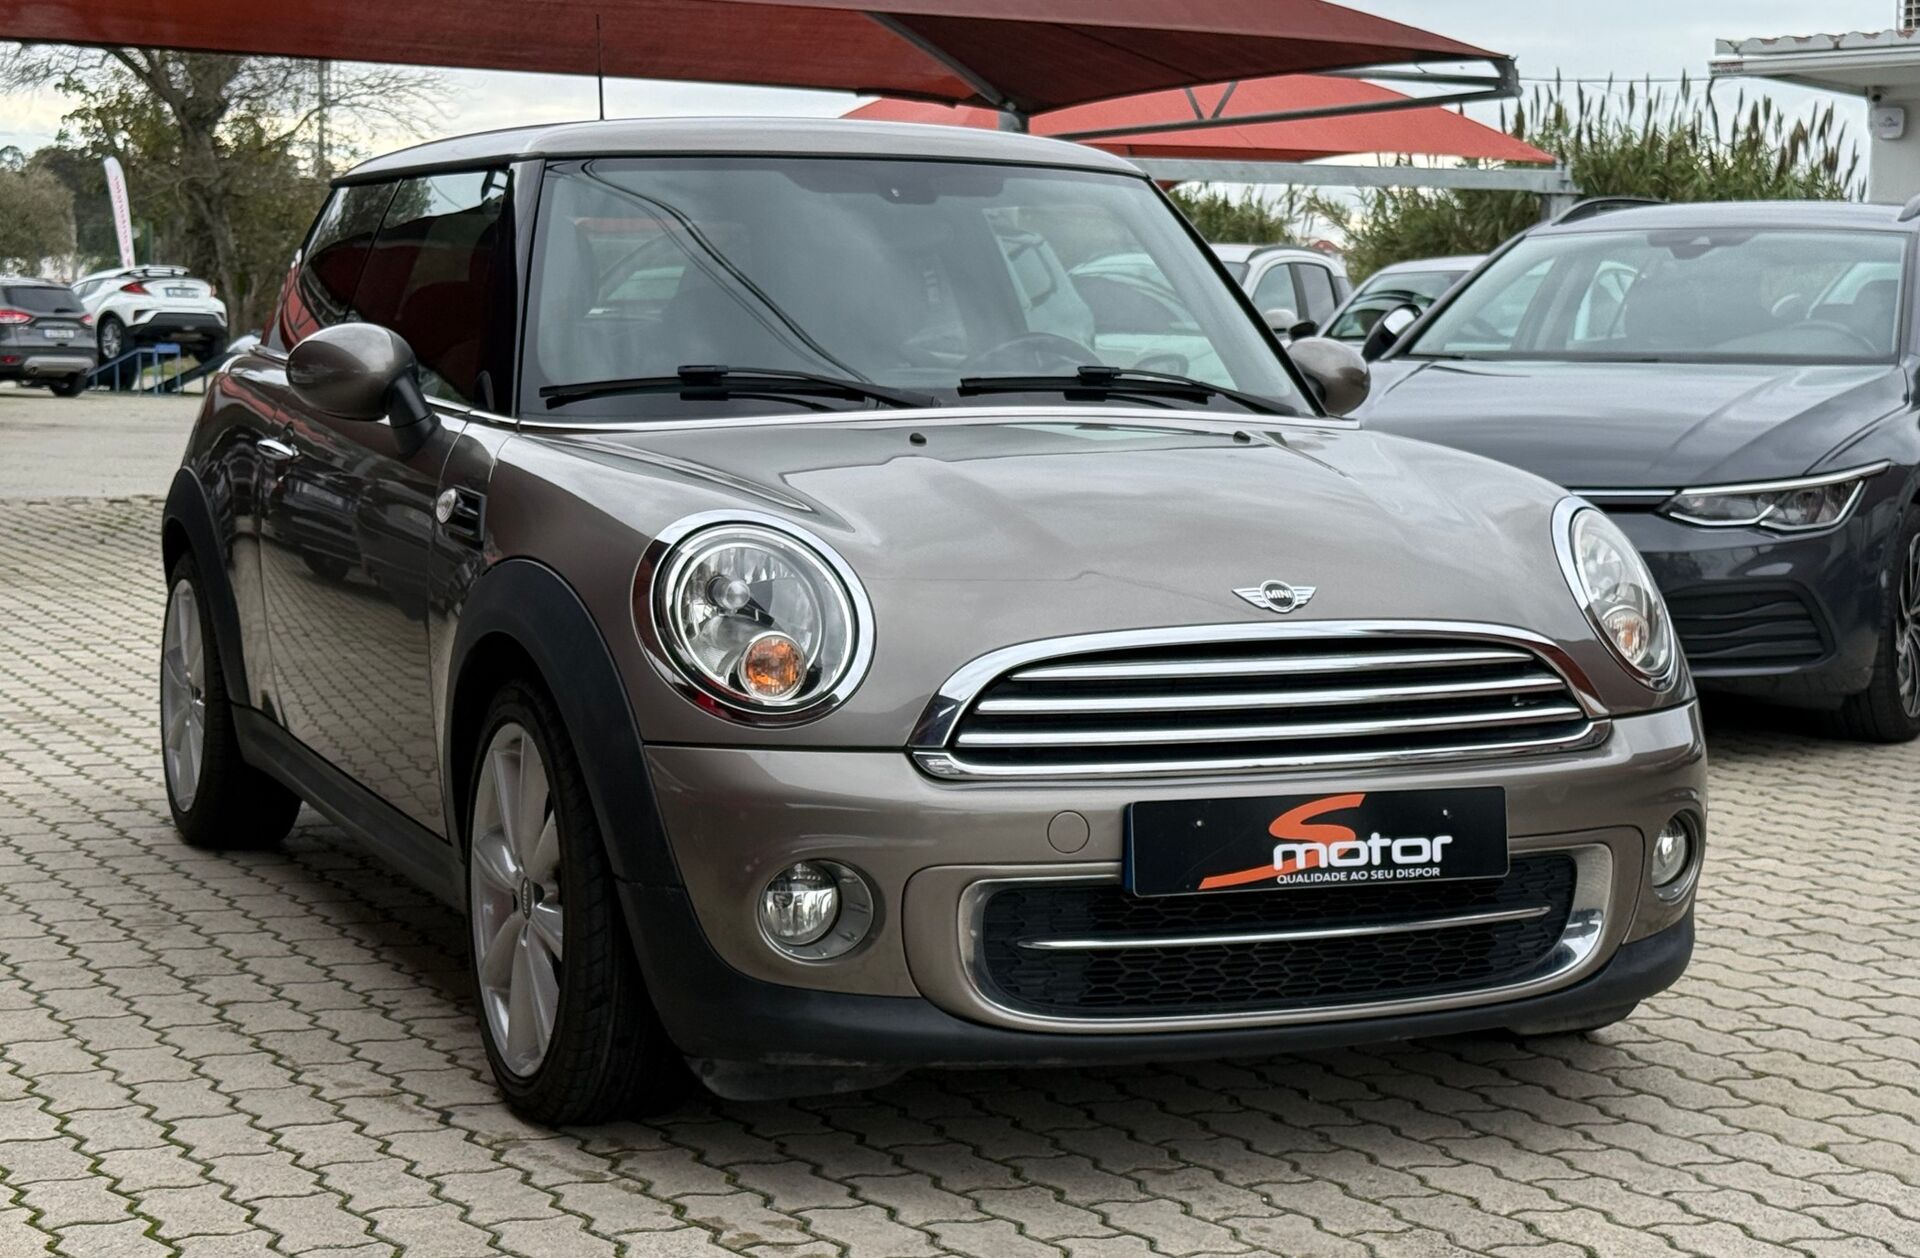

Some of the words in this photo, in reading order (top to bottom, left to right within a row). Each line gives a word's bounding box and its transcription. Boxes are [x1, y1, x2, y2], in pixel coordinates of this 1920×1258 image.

[1265, 589, 1292, 599] MINI
[1277, 870, 1348, 885] QUALIDADE
[1350, 870, 1368, 881] AO
[1370, 869, 1394, 880] SEU
[1396, 867, 1440, 879] DISPOR
